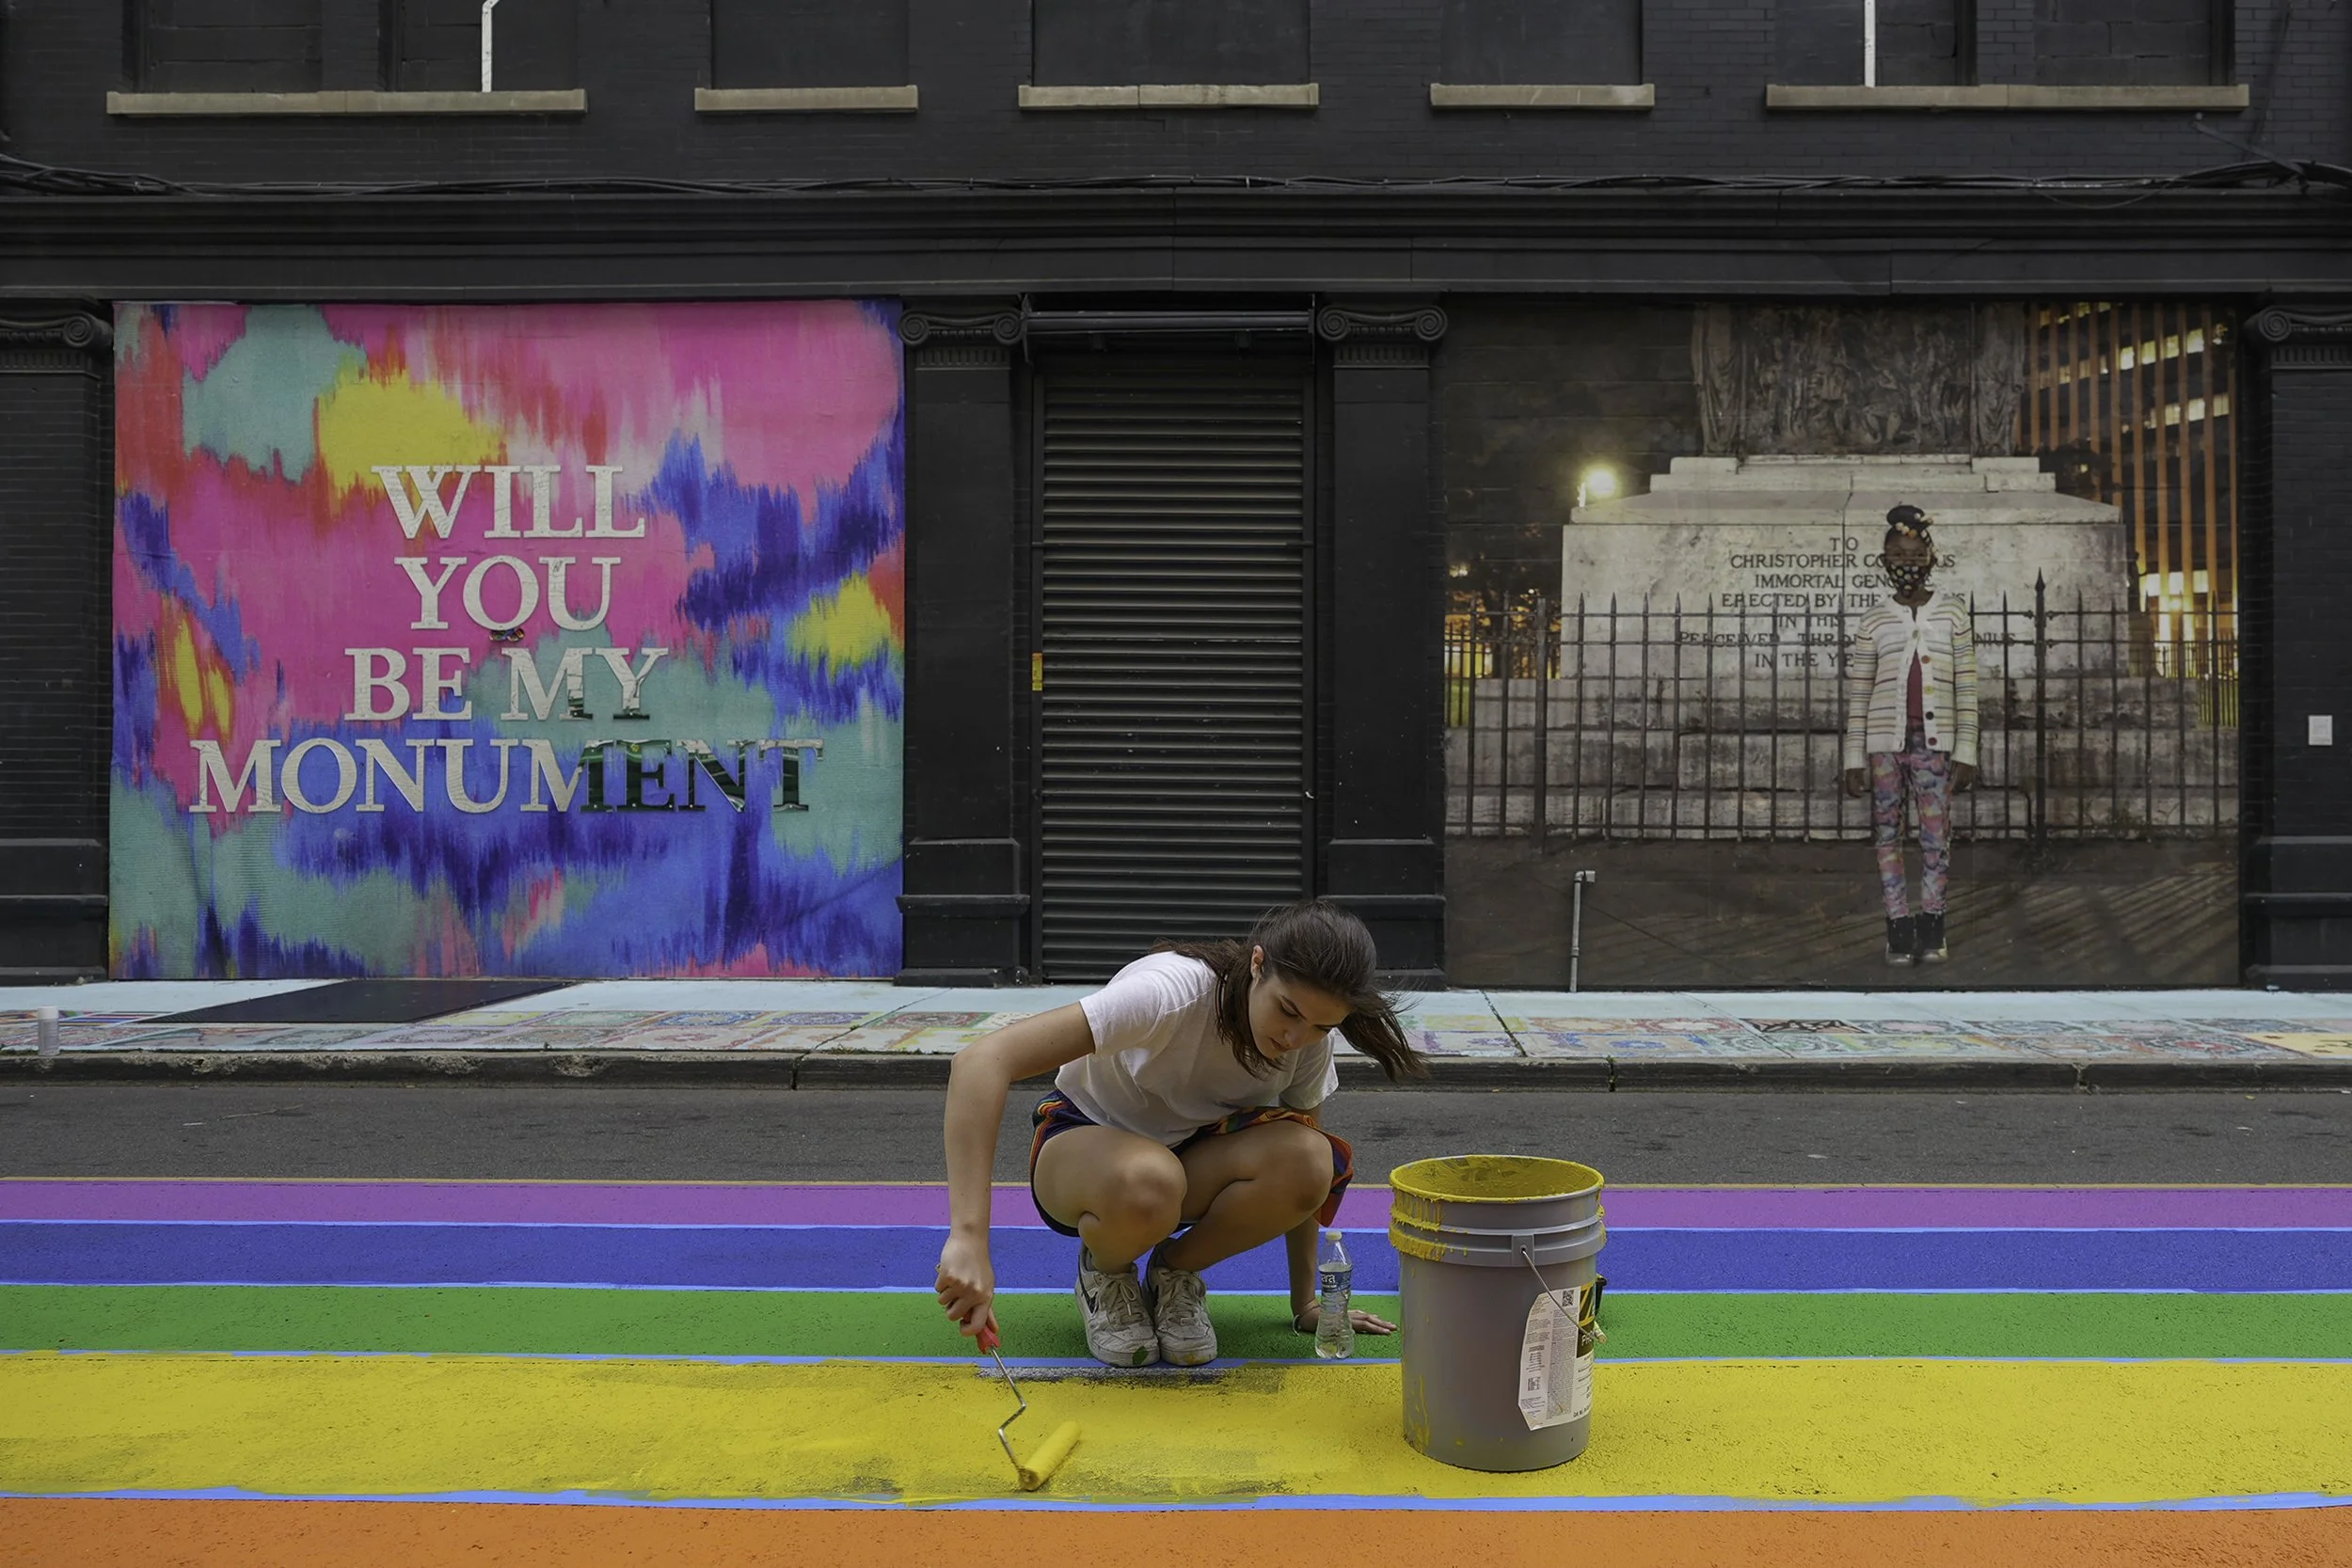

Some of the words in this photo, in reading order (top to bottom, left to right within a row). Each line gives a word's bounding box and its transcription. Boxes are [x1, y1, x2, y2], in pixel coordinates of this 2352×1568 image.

[371, 464, 646, 540] WILL
[1829, 536, 1859, 551] TO
[1730, 553, 1859, 569] CHRISTOPHER
[1755, 574, 1845, 589] IMMORTAL
[393, 554, 622, 632] YOU
[1722, 594, 1807, 608] ERECTED
[1815, 594, 1836, 608] BY
[1805, 614, 1845, 627] HIS
[1755, 653, 1774, 668] IN
[1782, 653, 1820, 668] THE
[344, 647, 473, 722] BE
[500, 647, 669, 722] MY
[188, 738, 824, 814] MONUMENT
